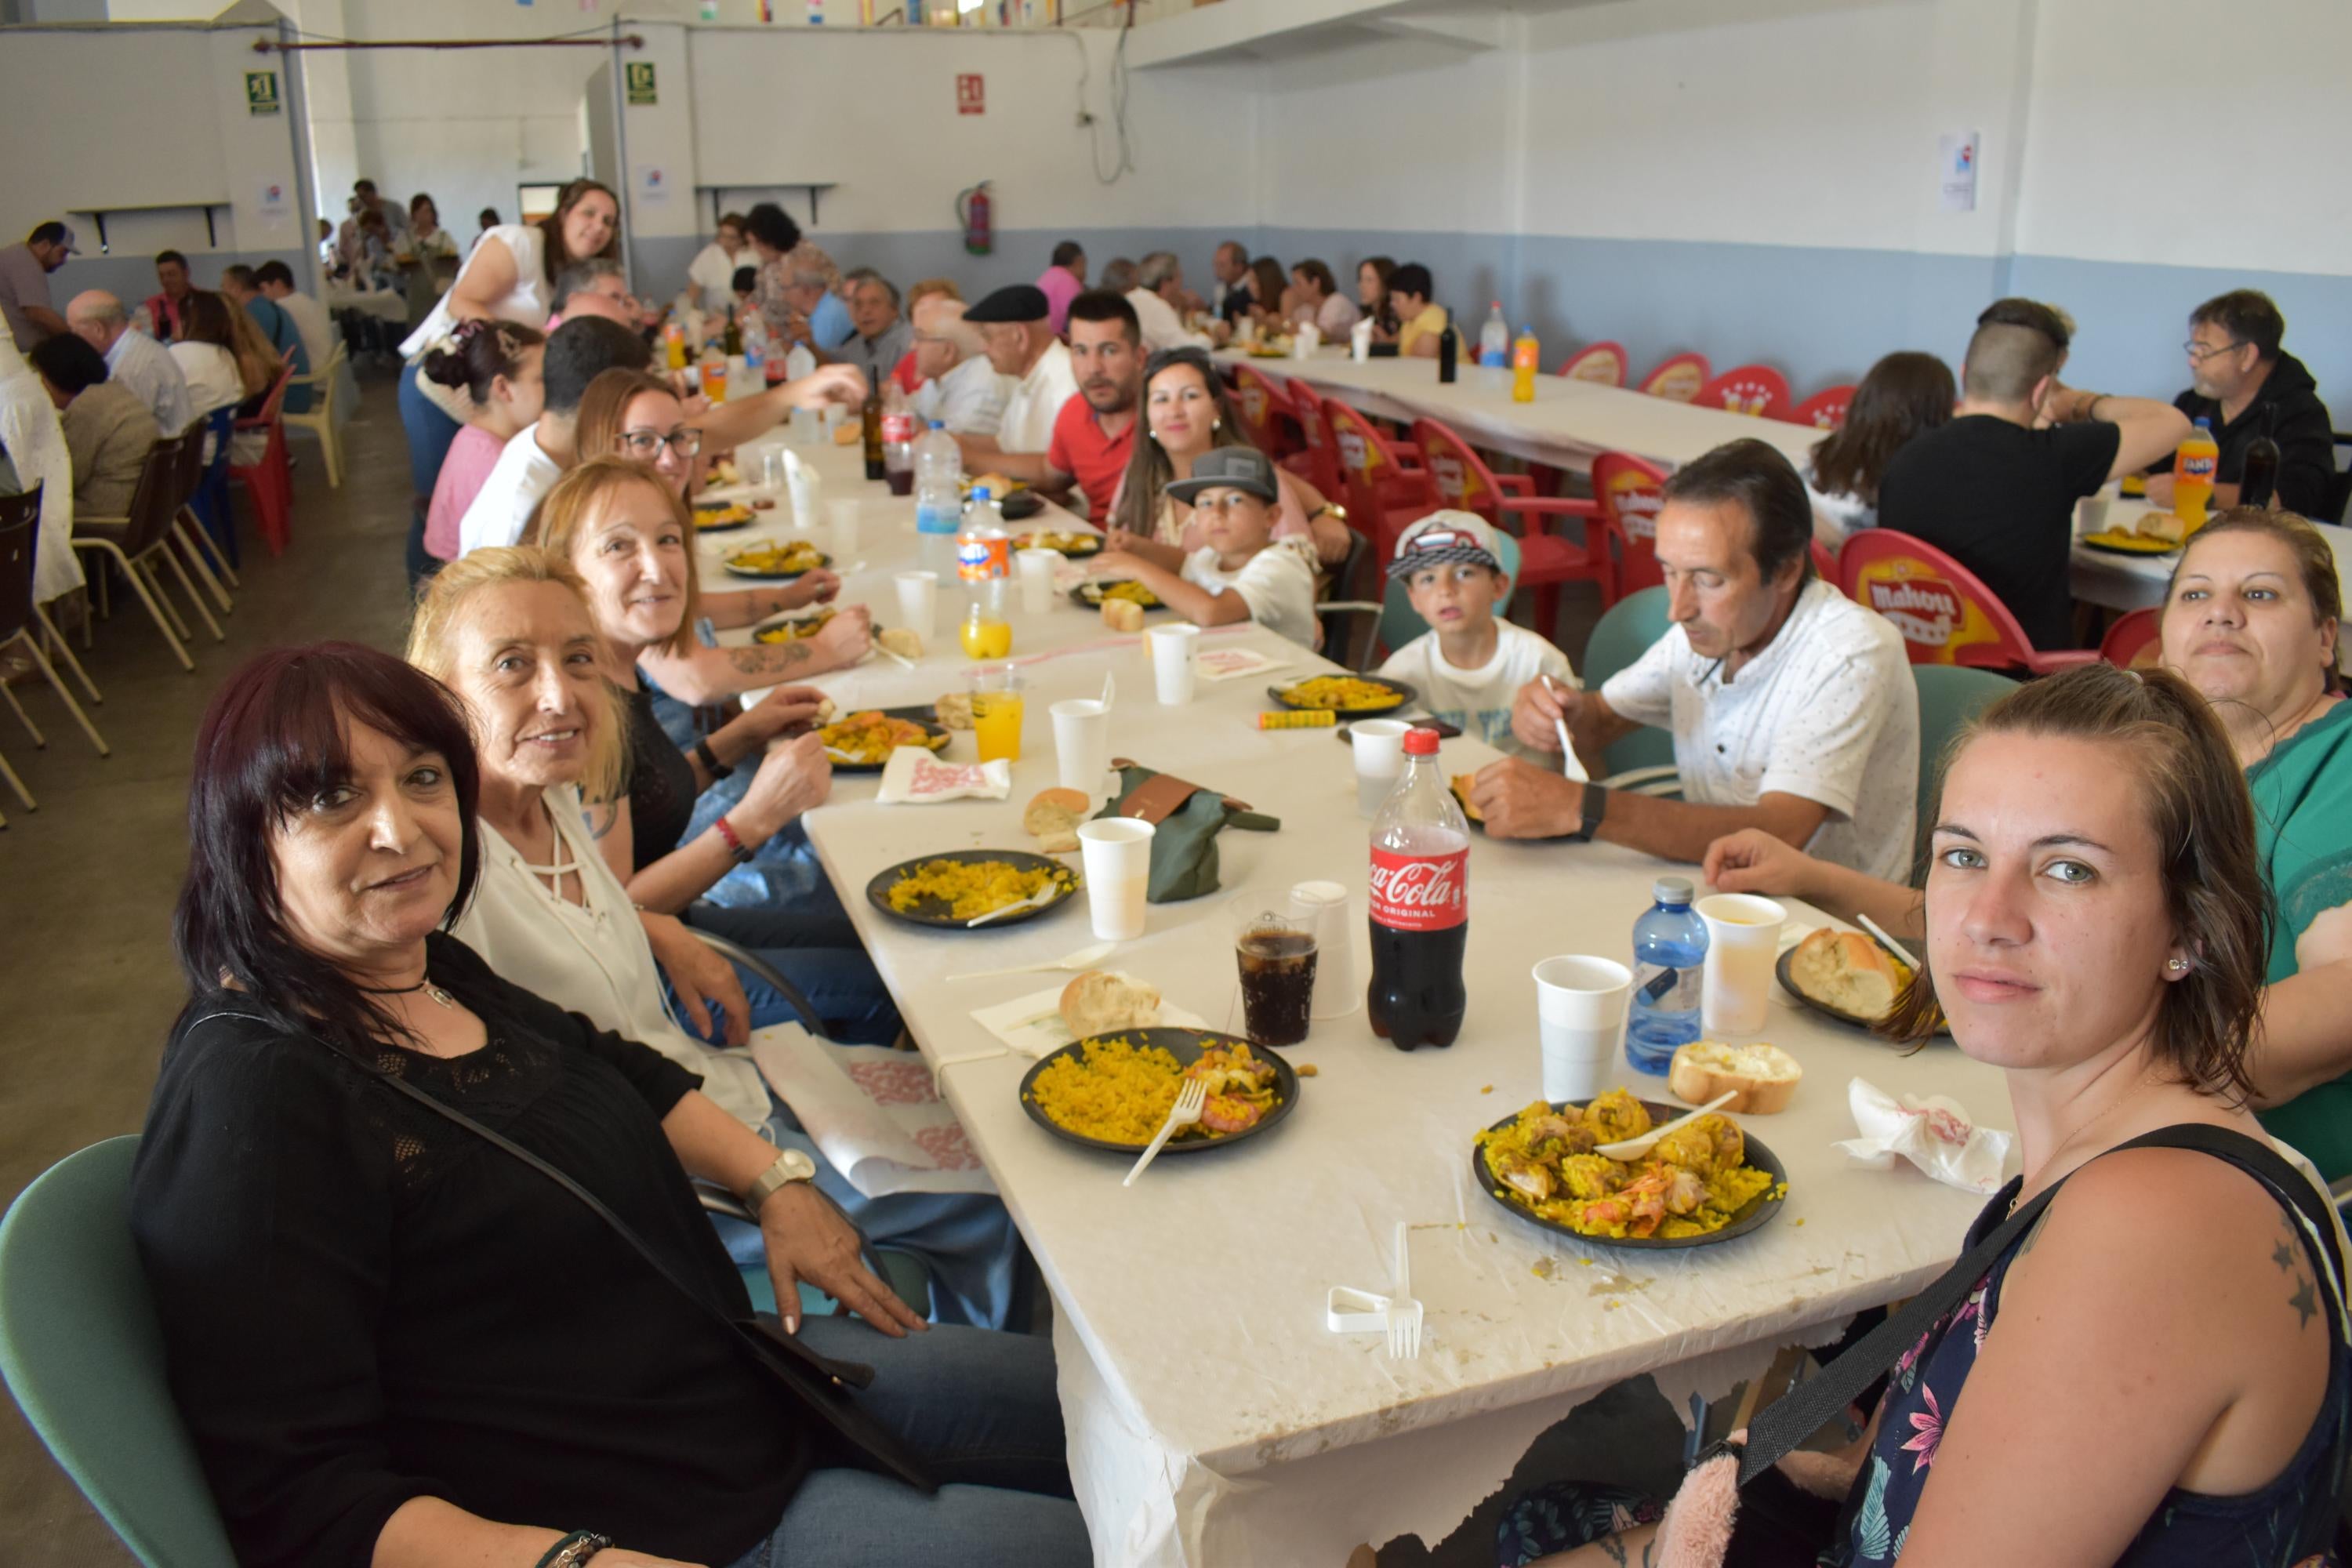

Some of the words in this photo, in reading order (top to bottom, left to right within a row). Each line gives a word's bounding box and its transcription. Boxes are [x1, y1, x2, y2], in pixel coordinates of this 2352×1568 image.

[1871, 582, 1957, 616] Mahou
[1369, 860, 1458, 906] ca-Cola
[1382, 905, 1436, 918] ORIGINAL
